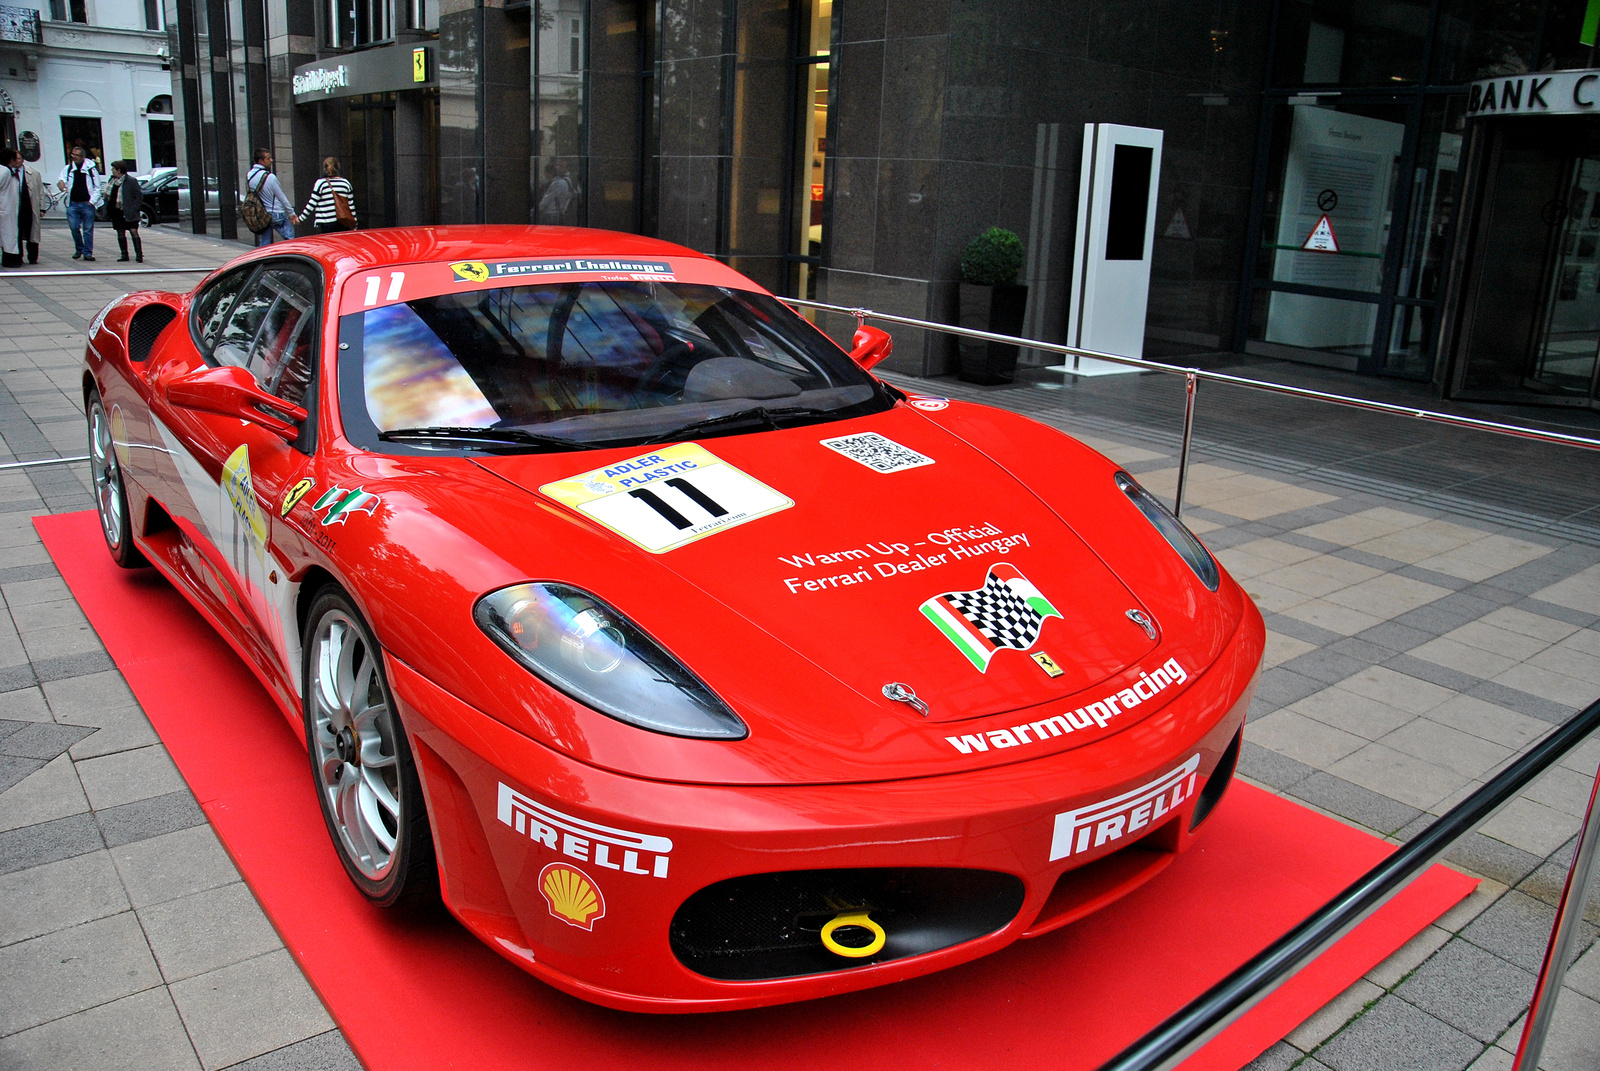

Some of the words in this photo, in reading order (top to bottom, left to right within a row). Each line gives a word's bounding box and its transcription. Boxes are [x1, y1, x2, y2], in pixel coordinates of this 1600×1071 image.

[1468, 77, 1553, 112] BANK
[496, 262, 571, 275] Ferrari
[575, 260, 665, 273] Challenge
[364, 271, 405, 306] 11
[604, 454, 666, 478] ADLER
[618, 460, 698, 487] PLASTIC
[627, 477, 729, 531] 11
[690, 512, 747, 534] Ferrari.com
[778, 549, 870, 569] Warm
[867, 541, 910, 557] Up
[927, 521, 1003, 546] Official
[783, 566, 873, 594] Ferrari
[873, 552, 948, 578] Dealer
[948, 532, 1031, 560] Hungary
[945, 657, 1188, 754] warmupracing
[1049, 753, 1201, 862] PIRELLI
[497, 781, 673, 878] PIRELLI
